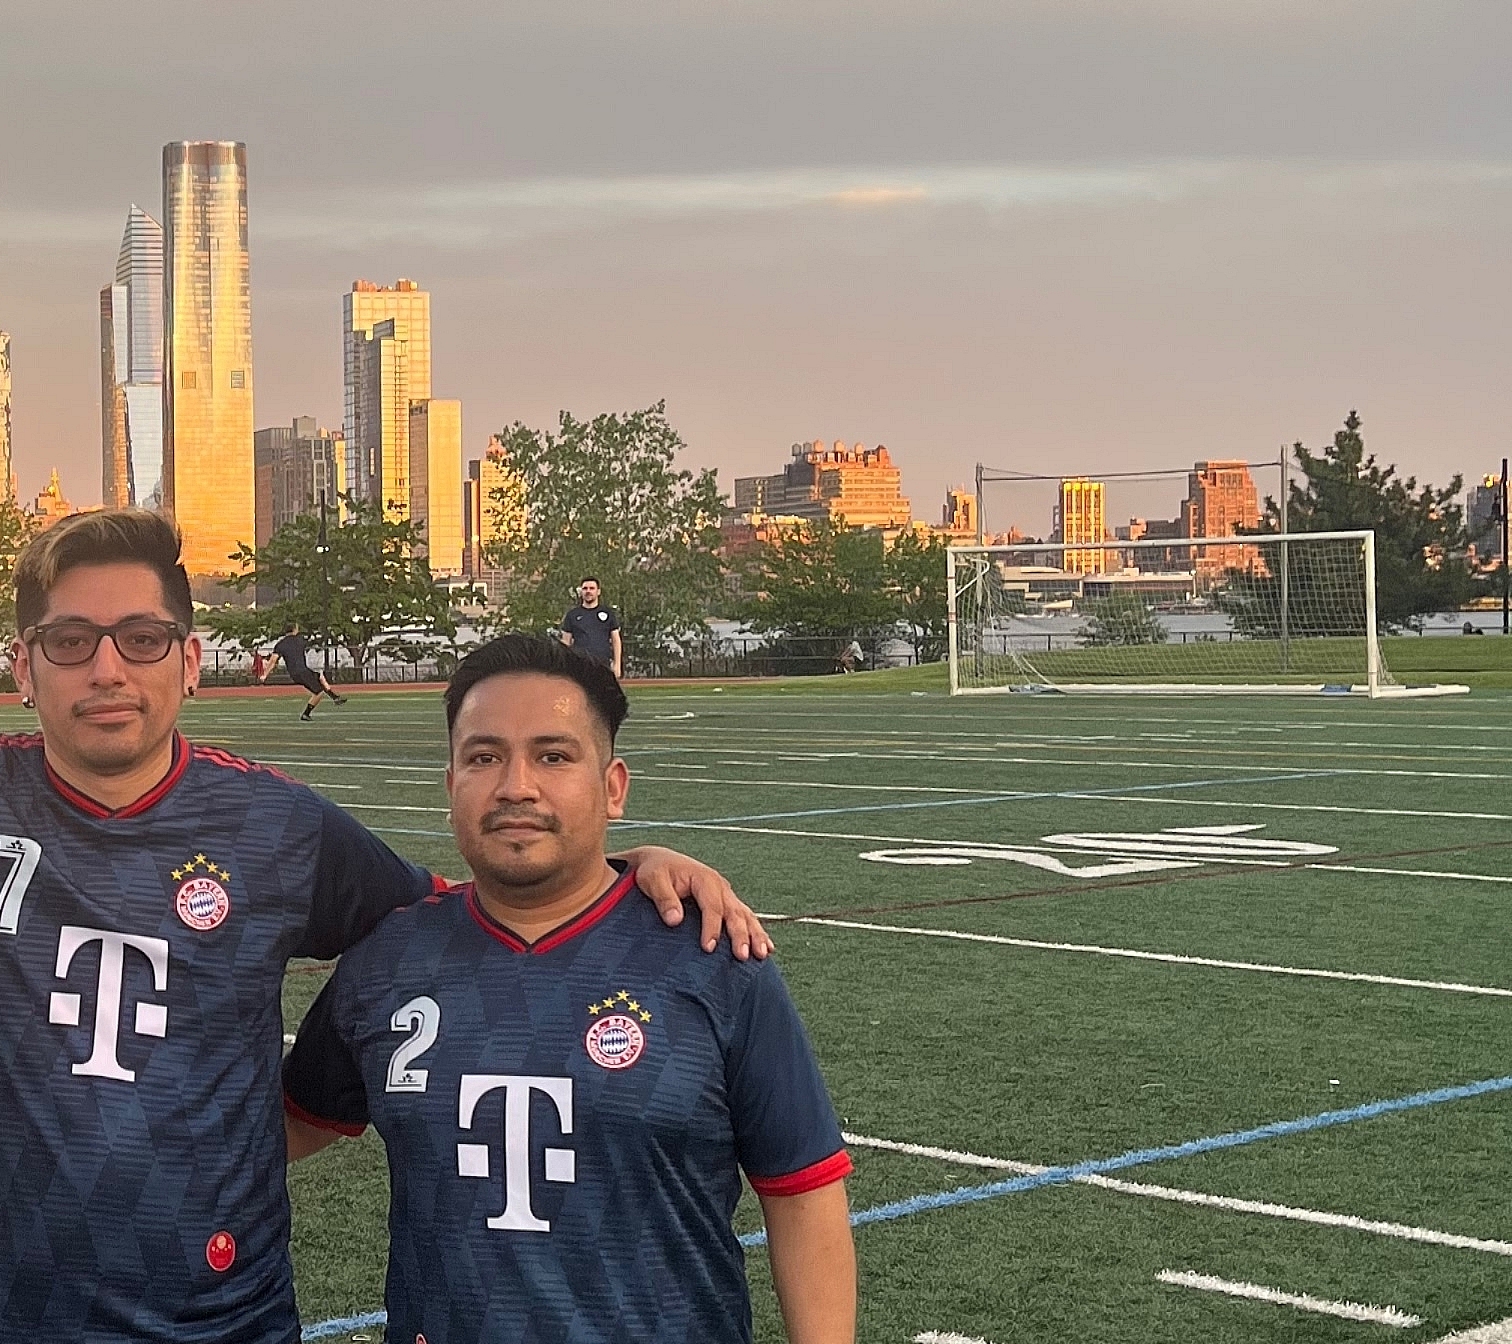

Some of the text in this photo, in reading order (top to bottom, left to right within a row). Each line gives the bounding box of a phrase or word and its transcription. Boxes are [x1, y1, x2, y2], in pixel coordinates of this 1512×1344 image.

[49, 925, 169, 1082] T
[385, 995, 441, 1092] 2
[457, 1074, 575, 1232] T
